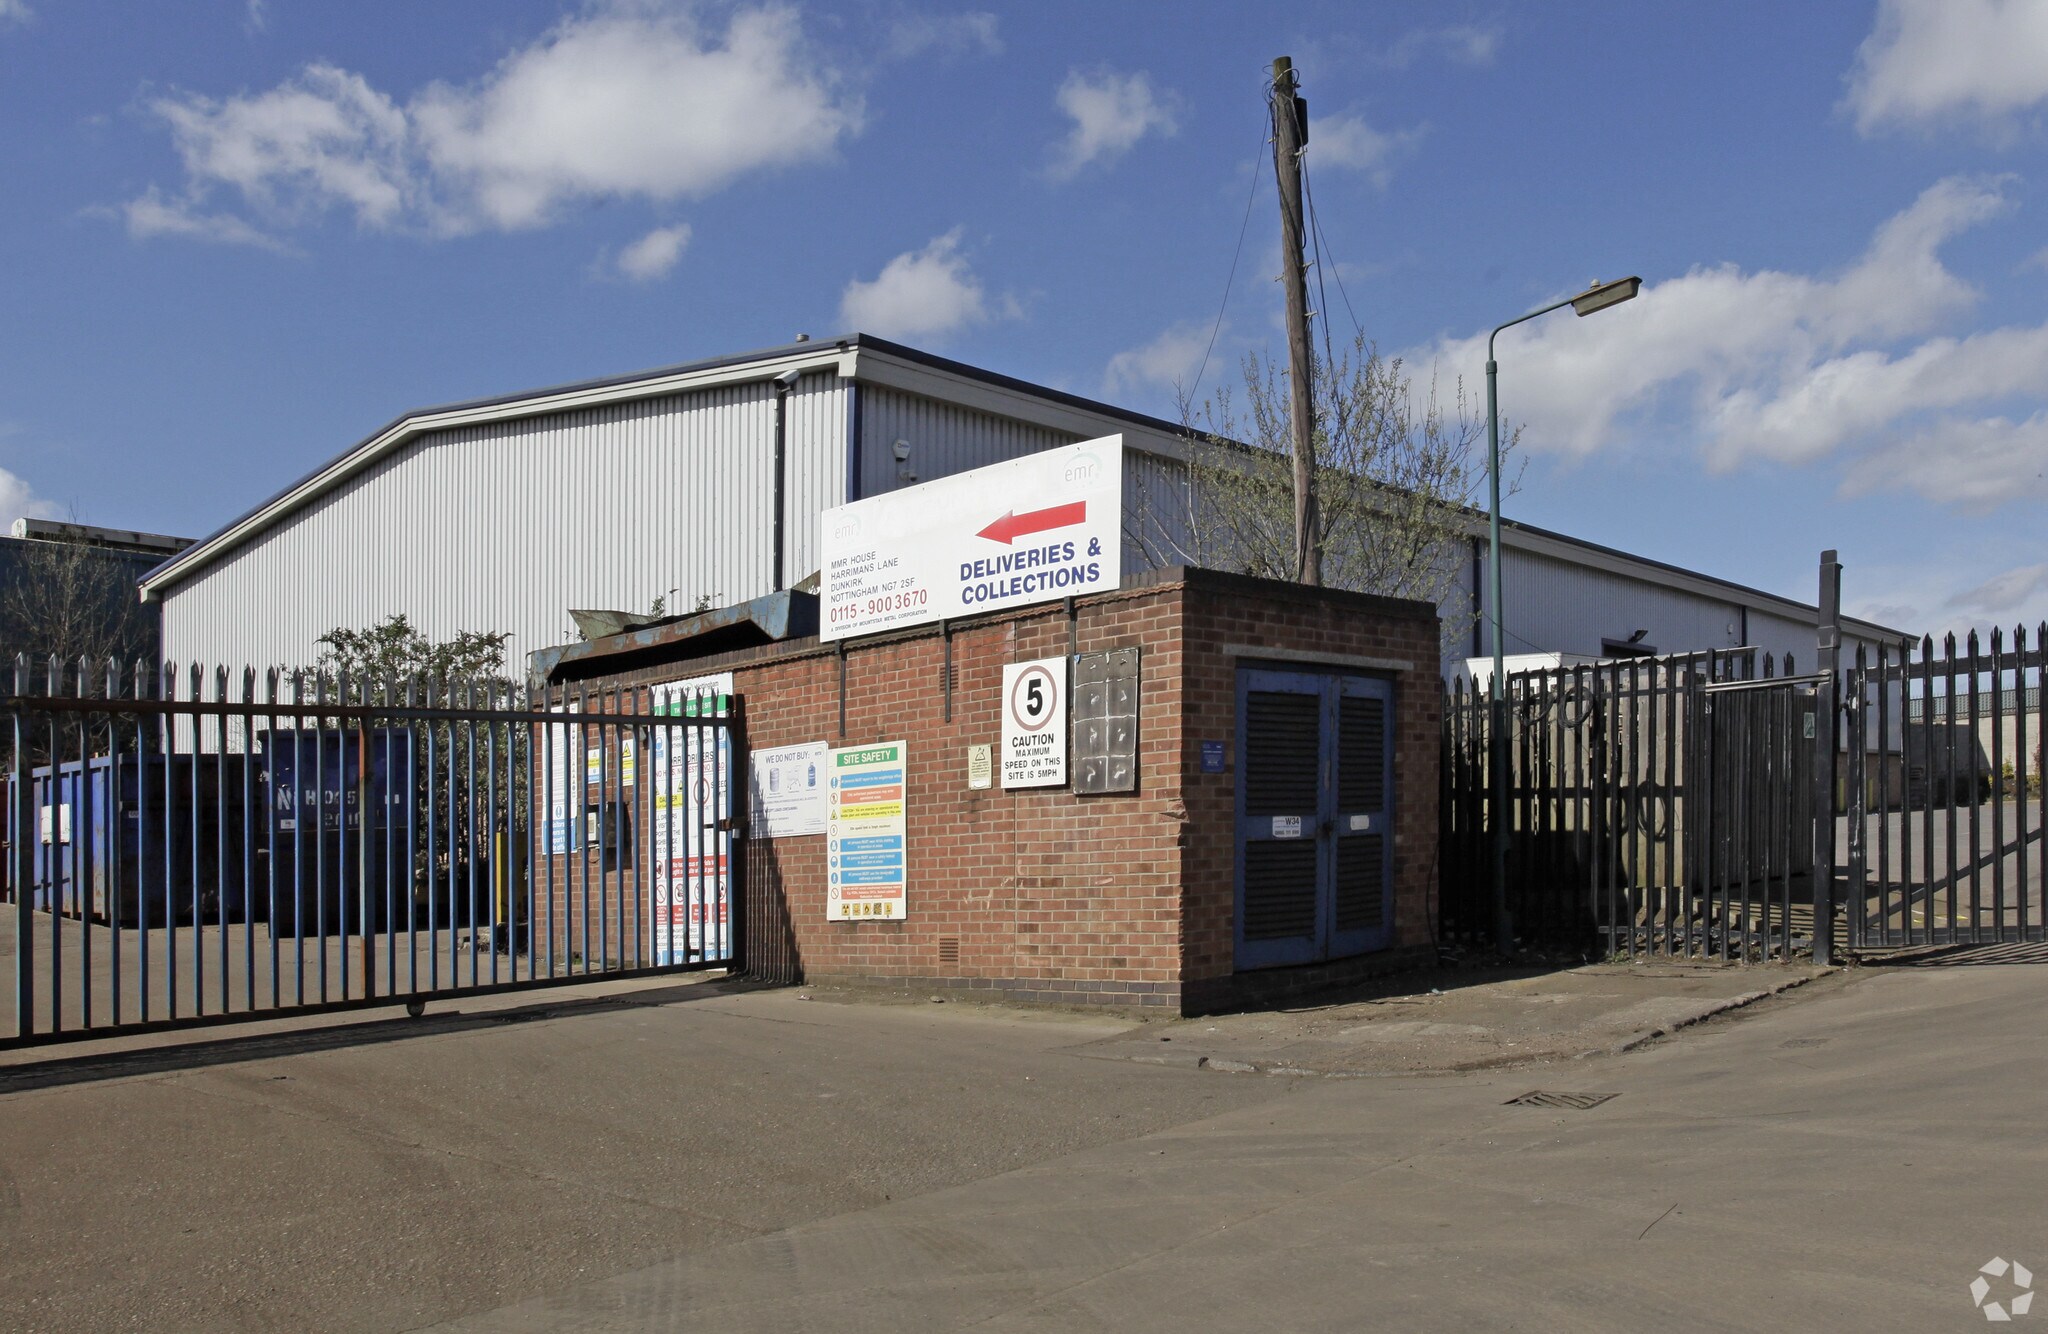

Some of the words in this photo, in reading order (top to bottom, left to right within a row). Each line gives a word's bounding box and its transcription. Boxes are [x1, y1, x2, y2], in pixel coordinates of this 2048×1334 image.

[1065, 463, 1094, 482] emr
[831, 558, 848, 570] MMR
[850, 551, 876, 565] HOUSE
[831, 563, 875, 580] HARRIMANS
[877, 557, 899, 570] LANE
[960, 542, 1075, 581] DELIVERIES
[1087, 537, 1102, 557] &
[830, 585, 878, 603] NOTTINGHAM
[882, 581, 897, 592] NG7
[900, 577, 915, 589] 2SF
[831, 577, 863, 592] DUNKIRK
[962, 562, 1100, 605] COLLECTIONS
[830, 603, 857, 623] 0115
[868, 596, 892, 615] 900
[895, 588, 927, 610] 3670
[835, 624, 851, 632] DIVISION
[898, 609, 928, 619] CORPORATION
[1026, 678, 1043, 716] 5
[1012, 733, 1055, 748] CAUTION
[765, 755, 775, 764] WE
[776, 754, 783, 763] DO
[784, 752, 796, 762] NOT
[843, 753, 860, 765] SITE
[861, 750, 891, 763] SAFETY
[1015, 747, 1050, 758] MAXIMUM
[1005, 761, 1028, 770] SPEED
[1031, 759, 1041, 767] ON
[1045, 757, 1061, 766] THIS
[1008, 771, 1024, 780] SITE
[1027, 770, 1034, 778] IS
[1038, 769, 1057, 778] 5MPH
[1285, 817, 1299, 826] W34
